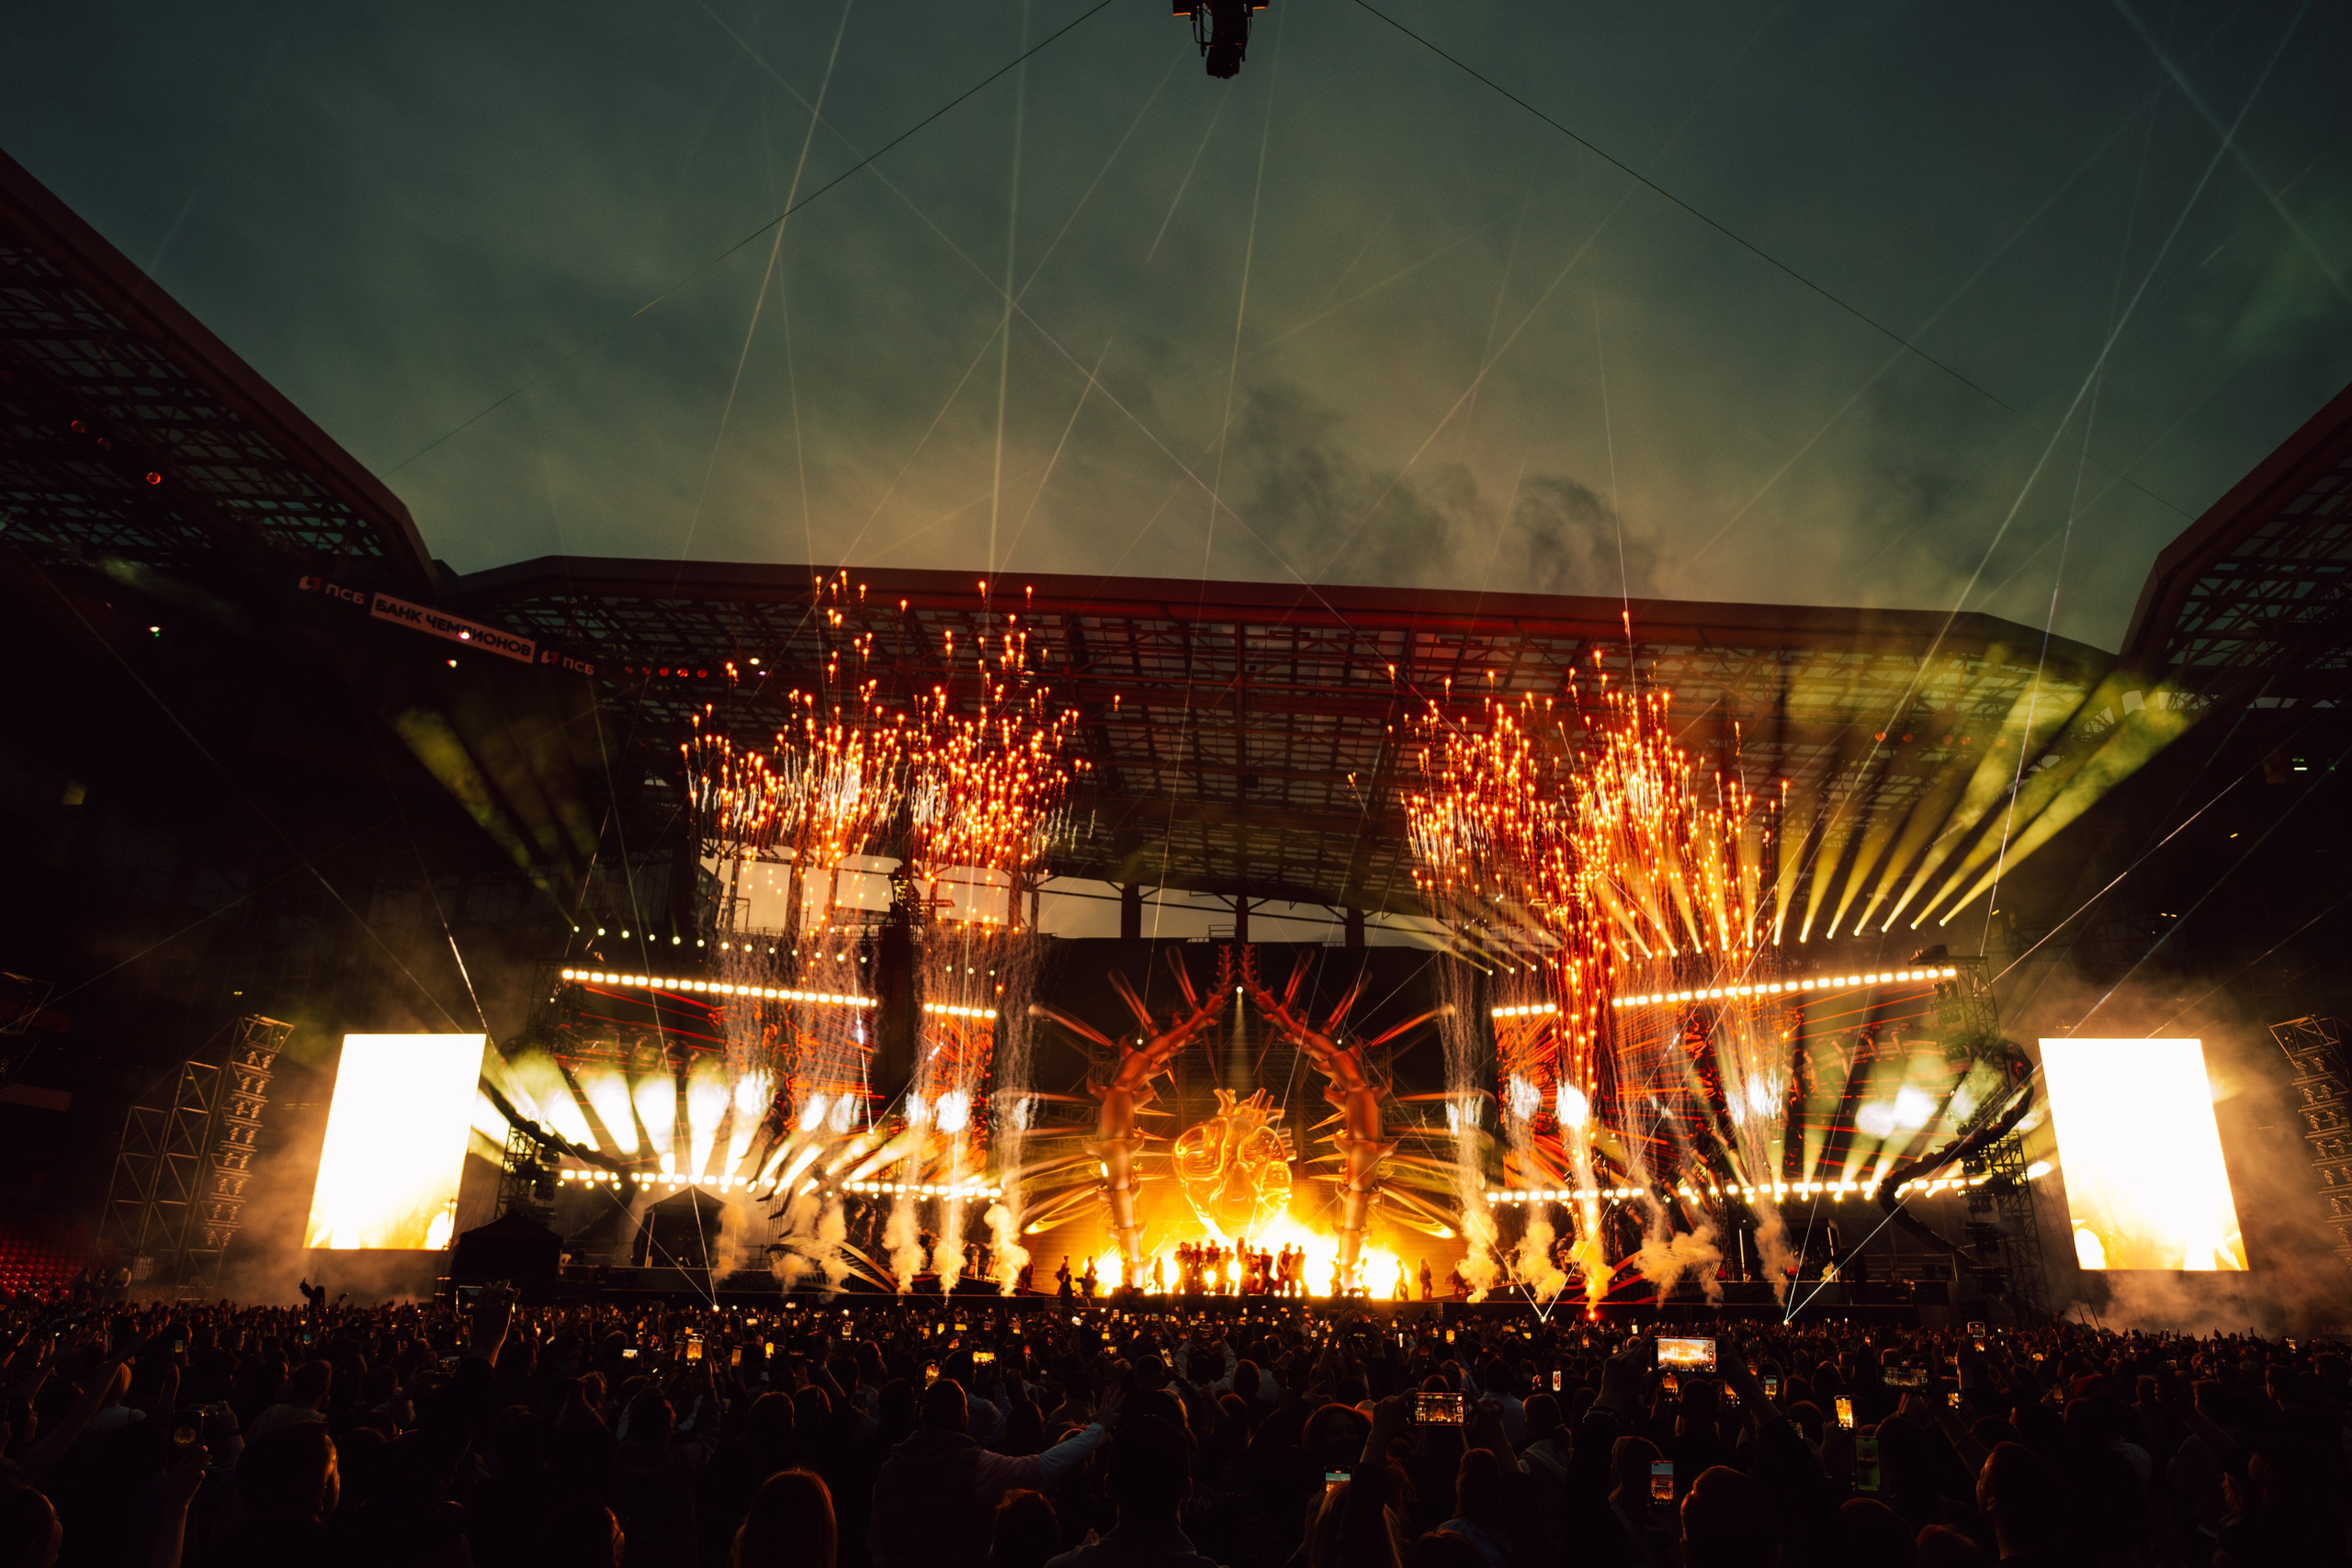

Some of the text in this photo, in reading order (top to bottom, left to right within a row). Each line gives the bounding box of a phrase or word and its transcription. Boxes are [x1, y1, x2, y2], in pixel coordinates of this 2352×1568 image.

[325, 582, 365, 604] ПСБ
[375, 599, 422, 625] БАНК
[562, 656, 594, 676] ПСБ
